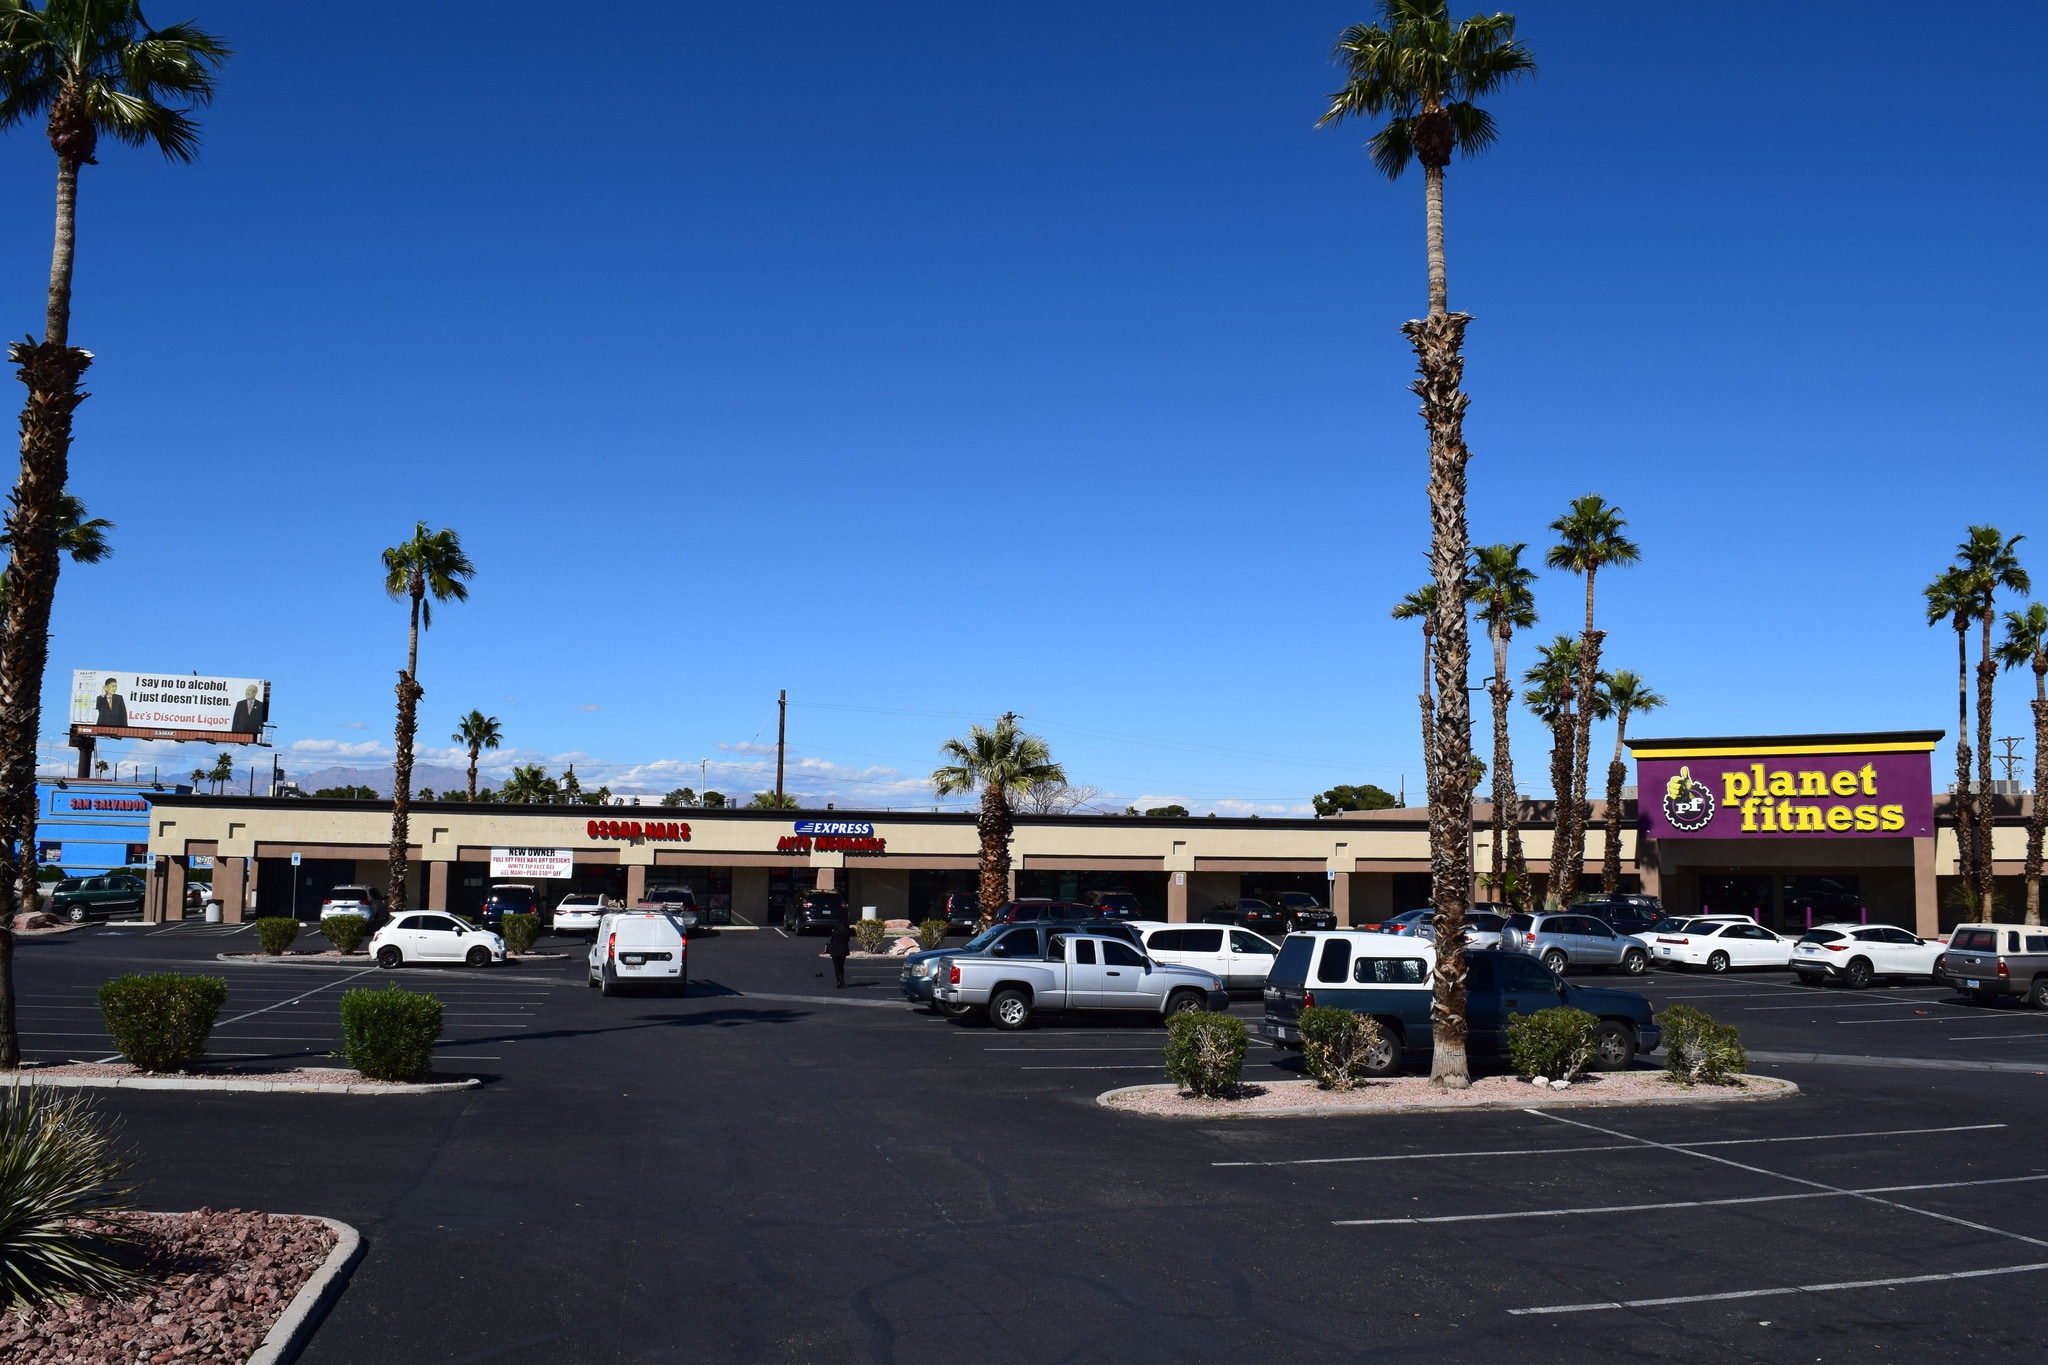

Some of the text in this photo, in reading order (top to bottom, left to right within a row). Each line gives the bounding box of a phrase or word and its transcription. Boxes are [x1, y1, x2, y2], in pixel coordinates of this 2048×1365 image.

[136, 676, 228, 692] I say no to alcohol,
[130, 691, 231, 706] it just doesn't listen.
[129, 711, 230, 726] Lee's Discount Liquor
[1721, 762, 1877, 807] planet
[70, 798, 147, 811] SAN SALVADOR
[1675, 797, 1703, 813] pf
[1740, 796, 1905, 832] fitness
[587, 820, 692, 840] OSCAR NAILS
[814, 823, 870, 834] EXPRESS
[509, 848, 555, 856] NEW OWNER
[777, 836, 886, 852] AUTO INSURANCE
